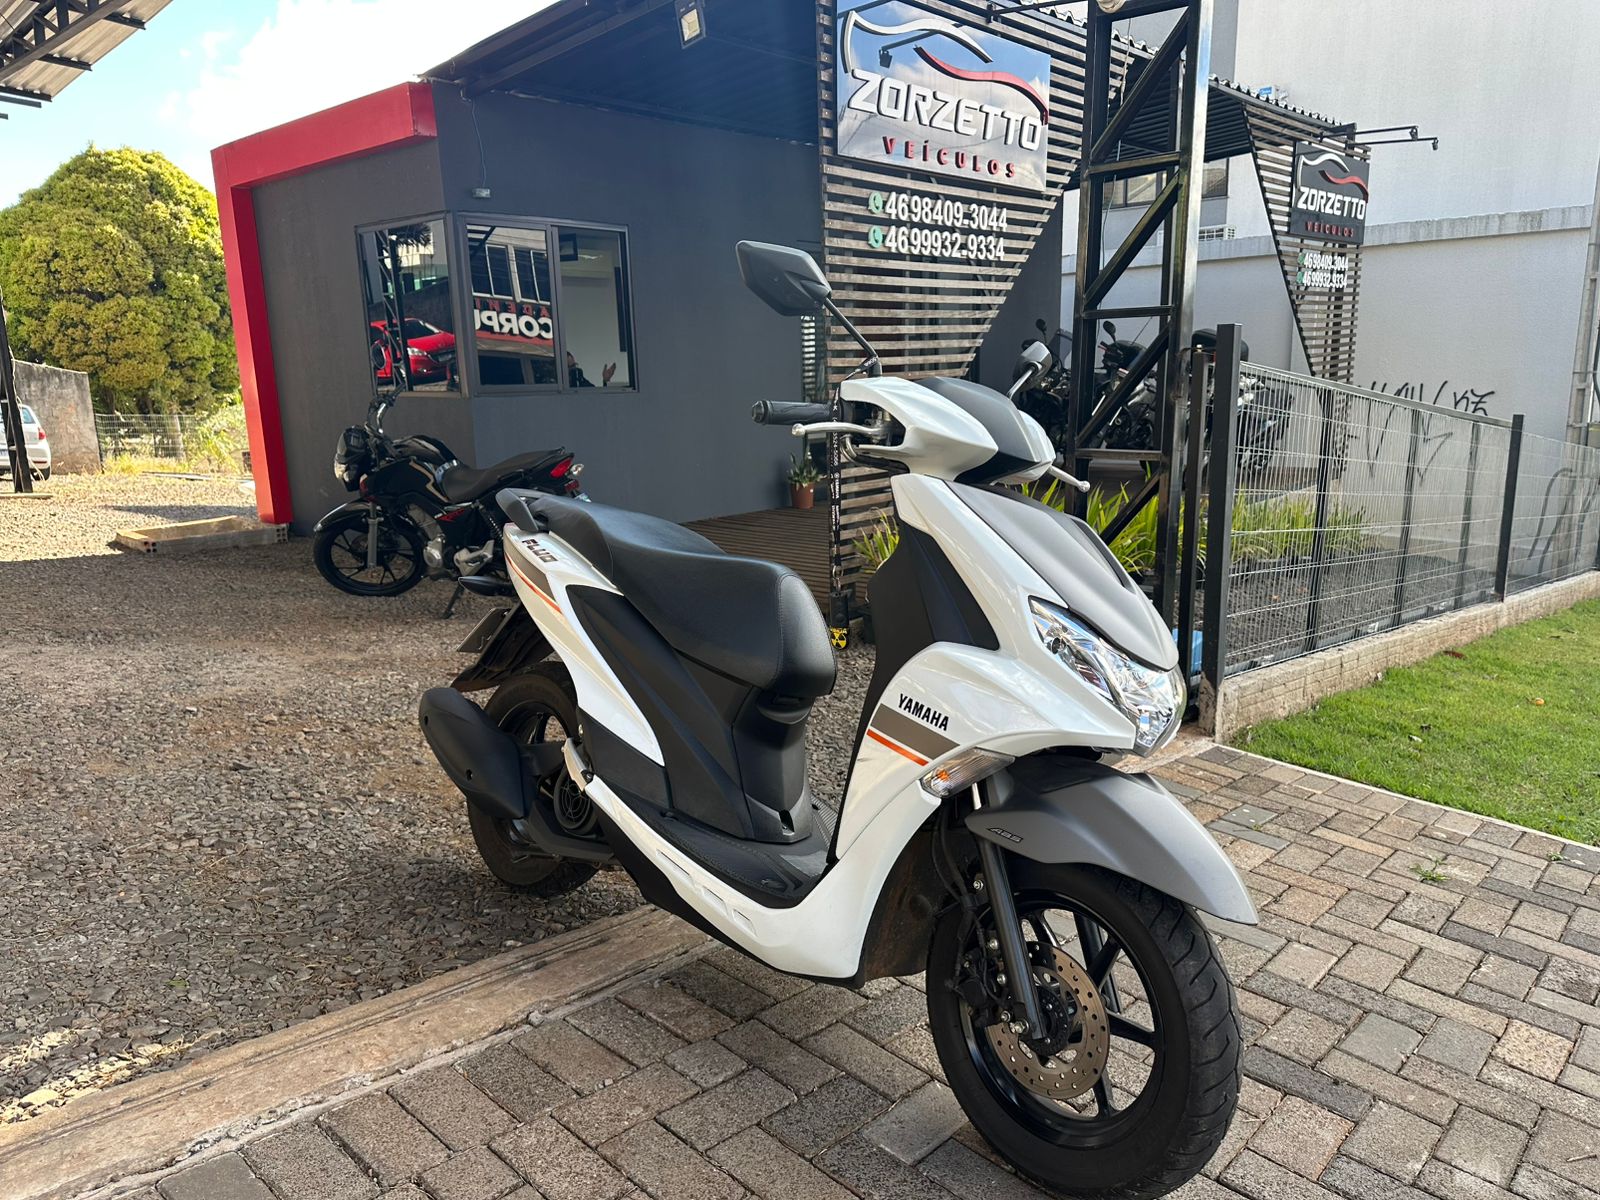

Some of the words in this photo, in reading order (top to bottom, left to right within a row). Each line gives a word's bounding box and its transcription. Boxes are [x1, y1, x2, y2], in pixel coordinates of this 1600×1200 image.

[848, 68, 1042, 151] ZORZETTO
[882, 135, 1016, 178] VEÍCULOS
[1297, 186, 1366, 220] ZORZETTO
[898, 693, 950, 731] YAMAHA
